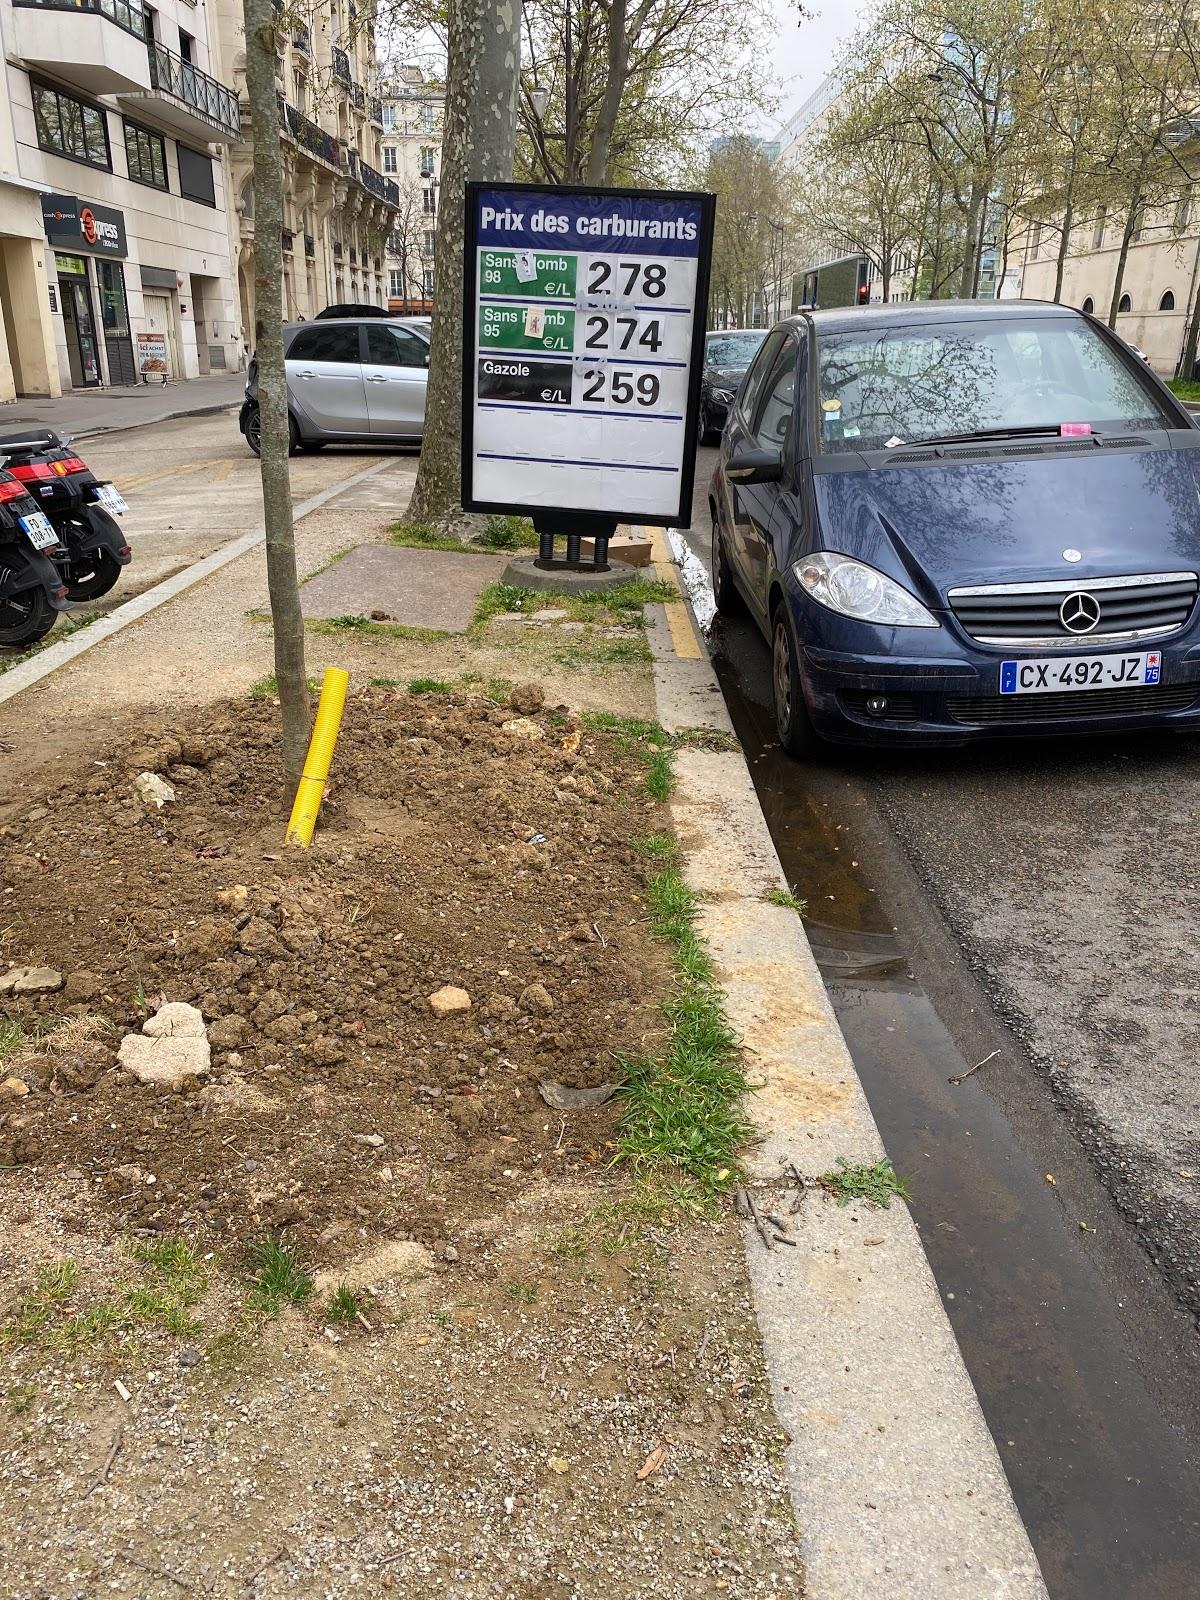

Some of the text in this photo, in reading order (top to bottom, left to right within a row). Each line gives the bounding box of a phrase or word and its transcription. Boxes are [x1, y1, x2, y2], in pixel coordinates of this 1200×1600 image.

[481, 207, 697, 240] Prix des carburants
[485, 253, 568, 271] Sans lomb
[485, 270, 501, 284] 98
[544, 282, 570, 296] €/L
[484, 308, 566, 326] Sans Pmb
[484, 324, 500, 337] 95
[585, 316, 662, 352] 274
[542, 336, 569, 350] €/L
[483, 361, 530, 377] Gazole
[540, 389, 567, 402] €/L
[582, 370, 660, 406] 259
[1020, 658, 1140, 688] CX-492-JZ
[1147, 669, 1159, 680] 75
